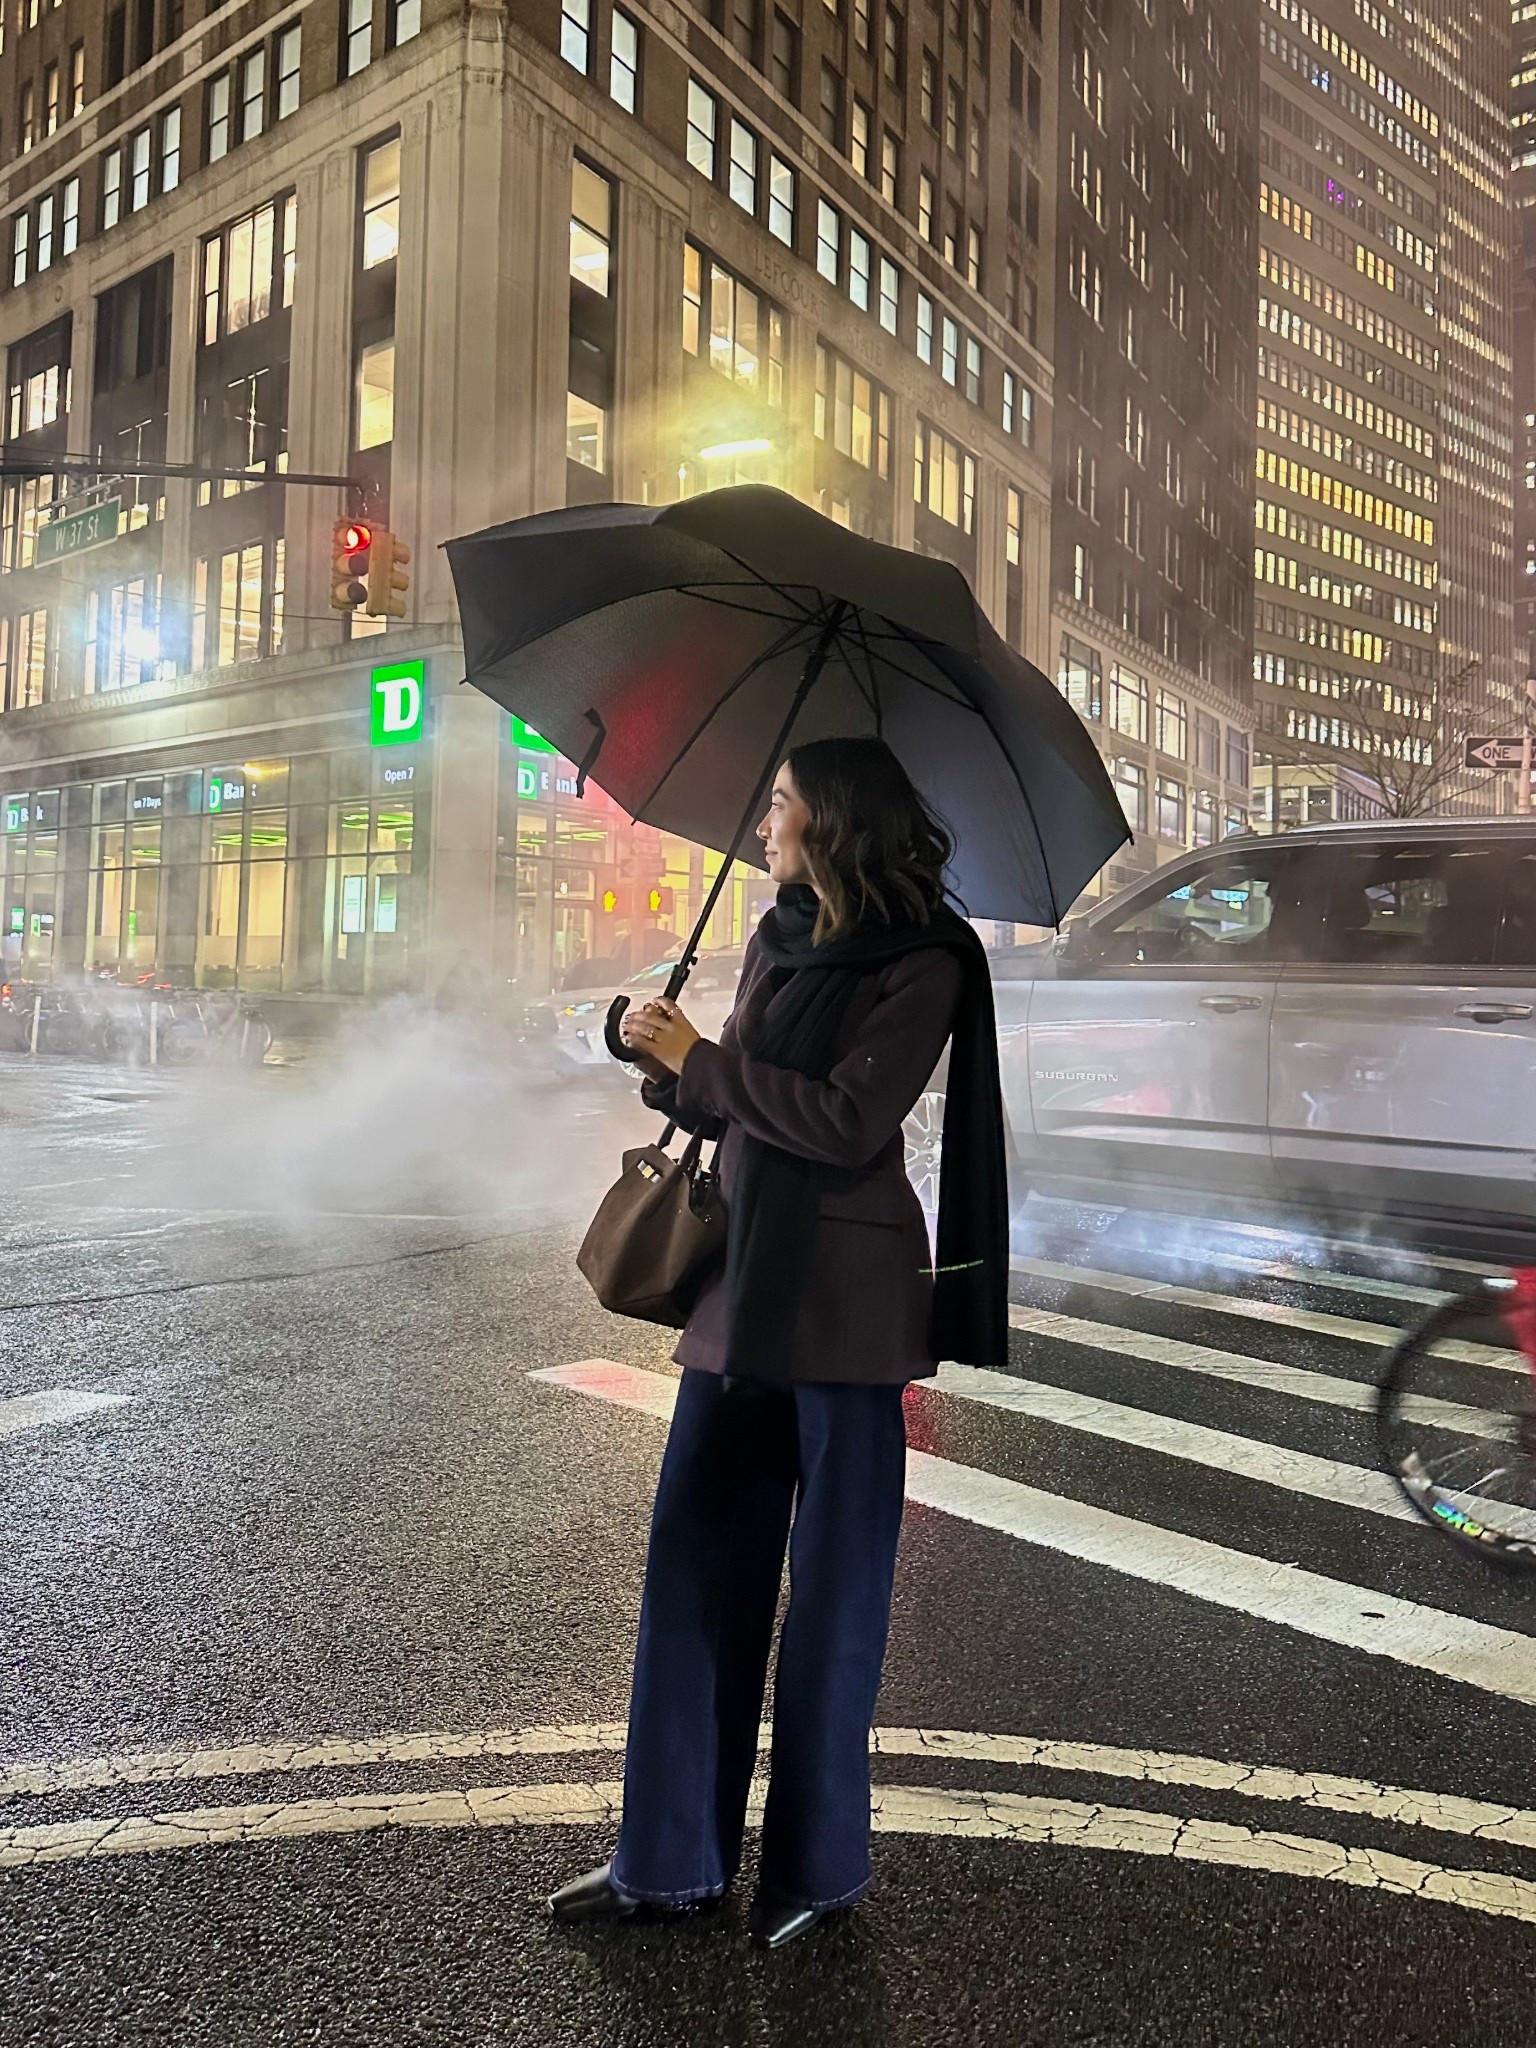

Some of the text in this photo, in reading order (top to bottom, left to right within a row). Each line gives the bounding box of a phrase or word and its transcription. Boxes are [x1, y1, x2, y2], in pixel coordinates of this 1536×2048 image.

[754, 247, 829, 321] LEFCOURT
[55, 513, 99, 552] W 37 St
[375, 677, 420, 733] TD
[1482, 746, 1511, 759] ONE
[384, 766, 414, 784] Open 7
[141, 797, 147, 809] 7
[147, 796, 162, 810] Days
[1034, 1070, 1119, 1082] SUBURBAN
